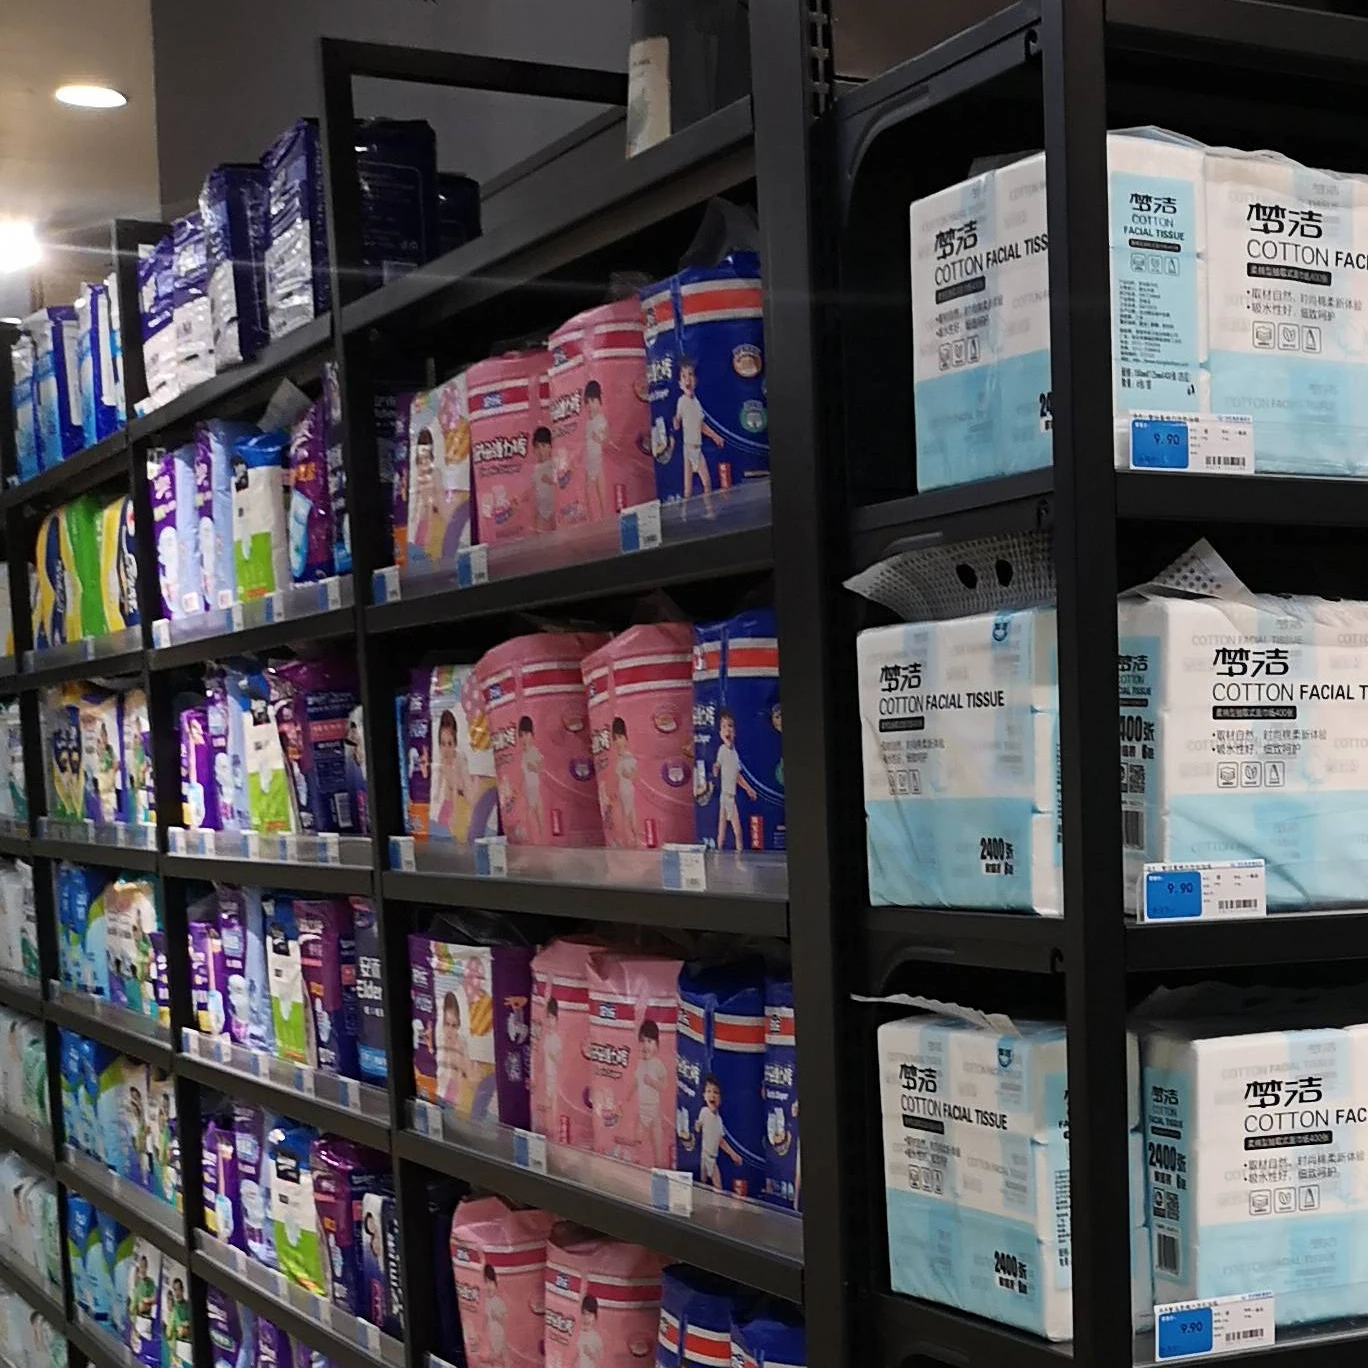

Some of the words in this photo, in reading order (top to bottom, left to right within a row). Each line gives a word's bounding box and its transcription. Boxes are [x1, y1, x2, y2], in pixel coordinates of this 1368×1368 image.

[1124, 226, 1152, 238] FACIAL
[1156, 229, 1185, 240] TISSUE
[1131, 214, 1174, 227] COTTON
[1247, 203, 1322, 238] 梦洁
[935, 220, 977, 260] 梦洁
[1247, 240, 1328, 266] COTTON
[935, 254, 983, 285] COTTON
[986, 243, 1021, 268] FACIAL
[1022, 233, 1049, 258] TISS
[1153, 433, 1180, 445] 9.90
[1213, 648, 1288, 677] 梦洁
[880, 663, 922, 692] 梦洁
[880, 696, 923, 715] COTTON
[926, 694, 963, 710] FACIAL
[966, 691, 1004, 707] TISSUE
[1213, 683, 1293, 701] COTTON
[1300, 685, 1354, 699] FACIAL
[981, 838, 1013, 860] 2400张
[1168, 882, 1194, 895] 9.90
[899, 1064, 937, 1093] 梦洁
[1244, 1077, 1322, 1108] 梦洁
[902, 1096, 941, 1117] COTTON
[944, 1104, 973, 1125] FACIAL
[975, 1109, 1007, 1130] TISSUE
[1245, 1110, 1328, 1132] COTTON
[1148, 1142, 1186, 1172] 2400张
[995, 1251, 1026, 1279] 2400张
[1180, 1321, 1204, 1334] 9.90
